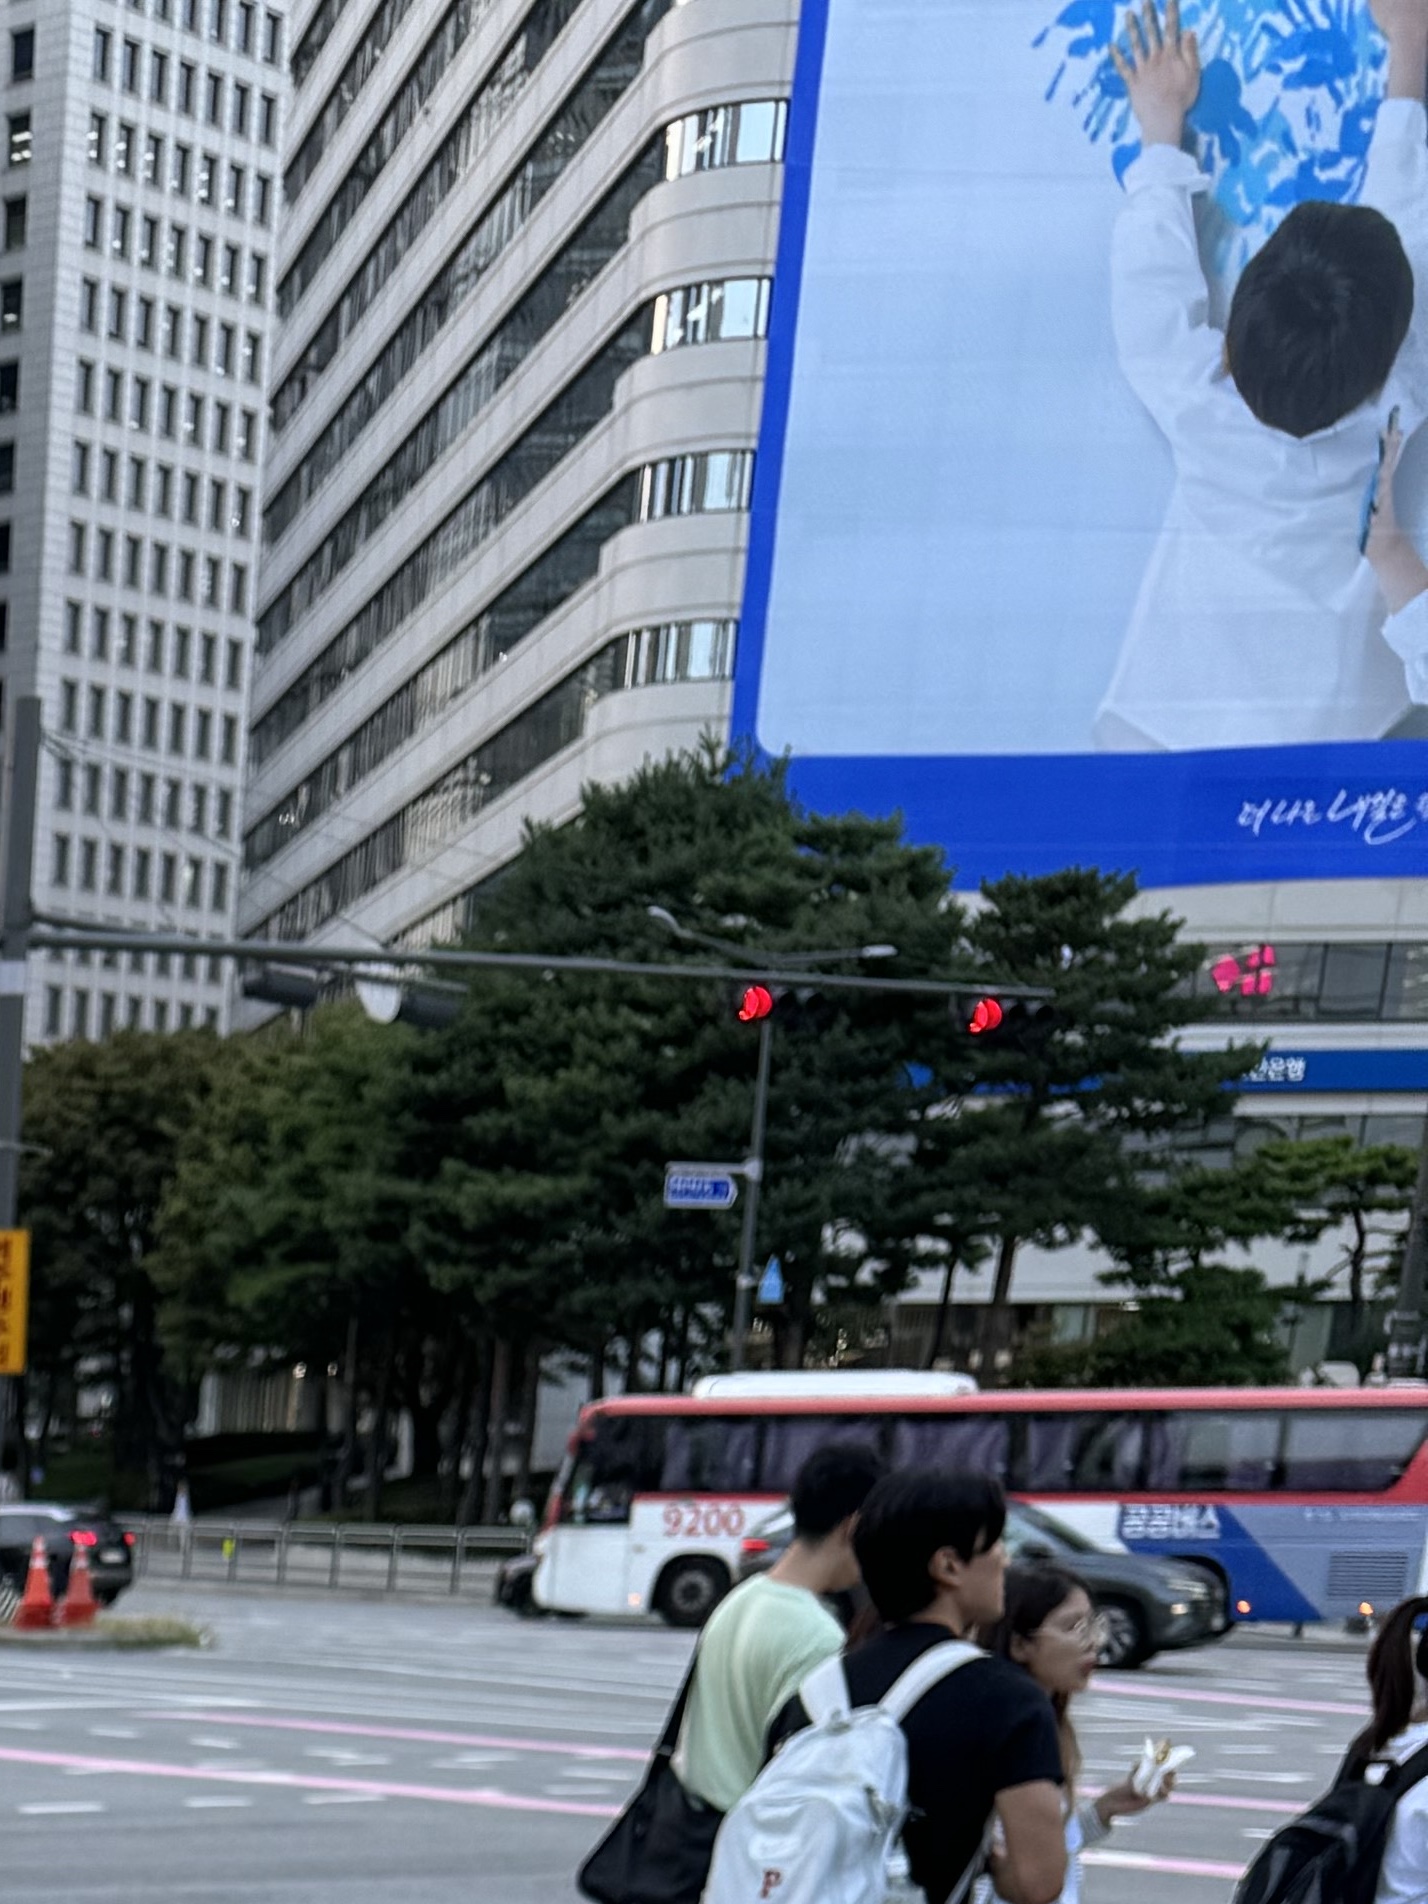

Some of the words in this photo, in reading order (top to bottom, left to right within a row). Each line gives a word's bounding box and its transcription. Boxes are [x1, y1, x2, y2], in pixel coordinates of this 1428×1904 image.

[1237, 798, 1272, 837] 더
[1271, 798, 1322, 825] 나은
[1327, 788, 1417, 845] 내일을
[662, 1502, 744, 1537] 9200
[759, 1867, 782, 1899] P
